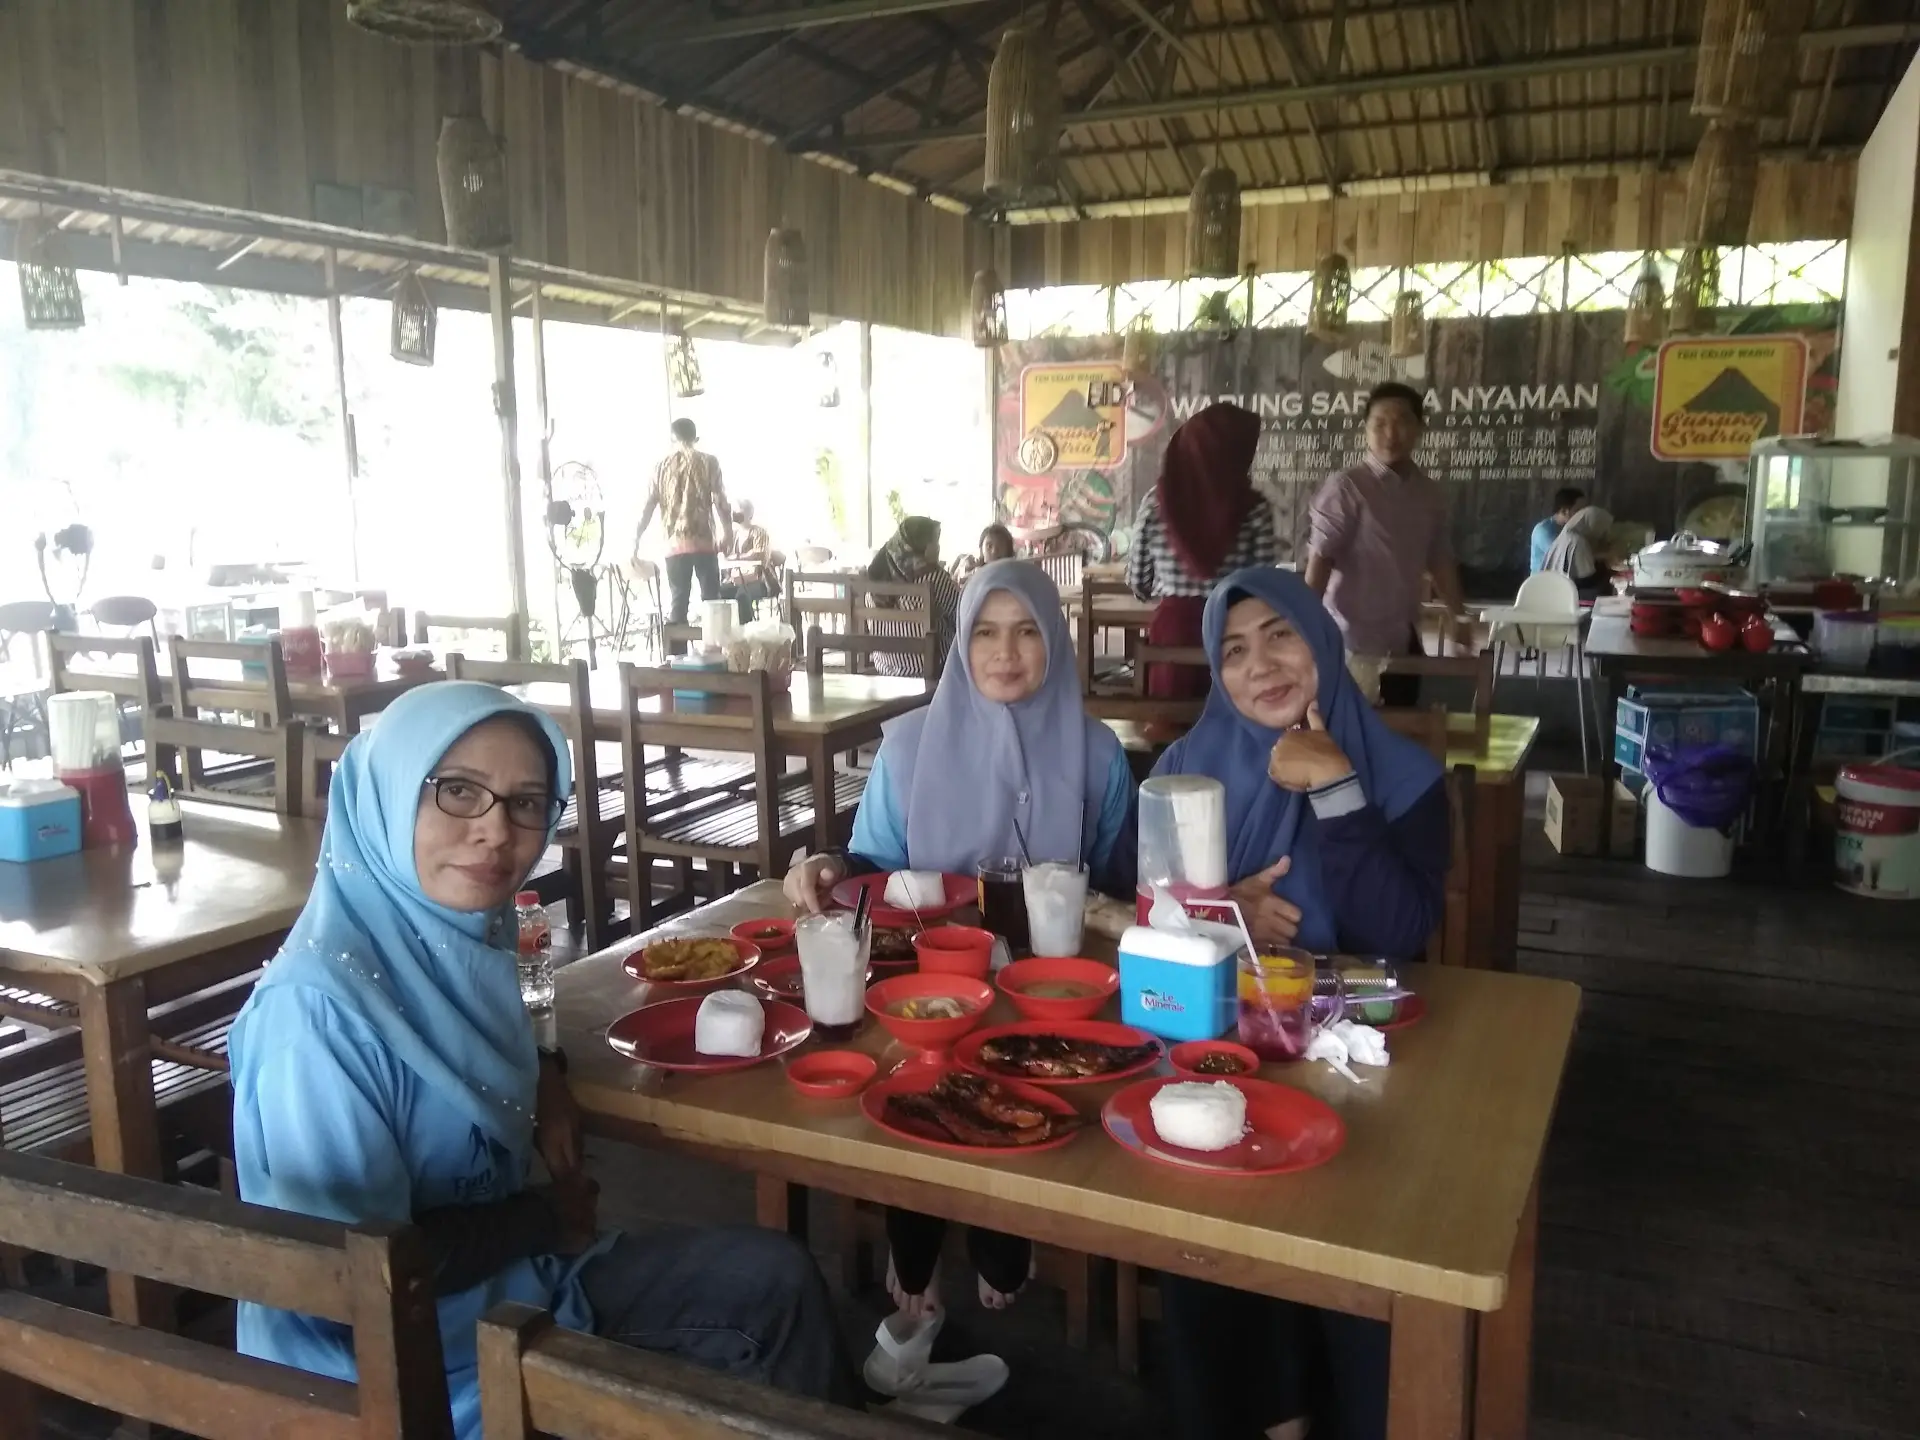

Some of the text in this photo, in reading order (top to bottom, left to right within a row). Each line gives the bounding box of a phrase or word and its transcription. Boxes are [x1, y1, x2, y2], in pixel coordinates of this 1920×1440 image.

[1451, 384, 1598, 412] NYAMAN
[1446, 412, 1524, 427] BANAR
[1661, 411, 1764, 438] Gunung
[1670, 429, 1753, 448] Satria
[1144, 996, 1185, 1013] Minerale
[1161, 991, 1174, 1002] Le
